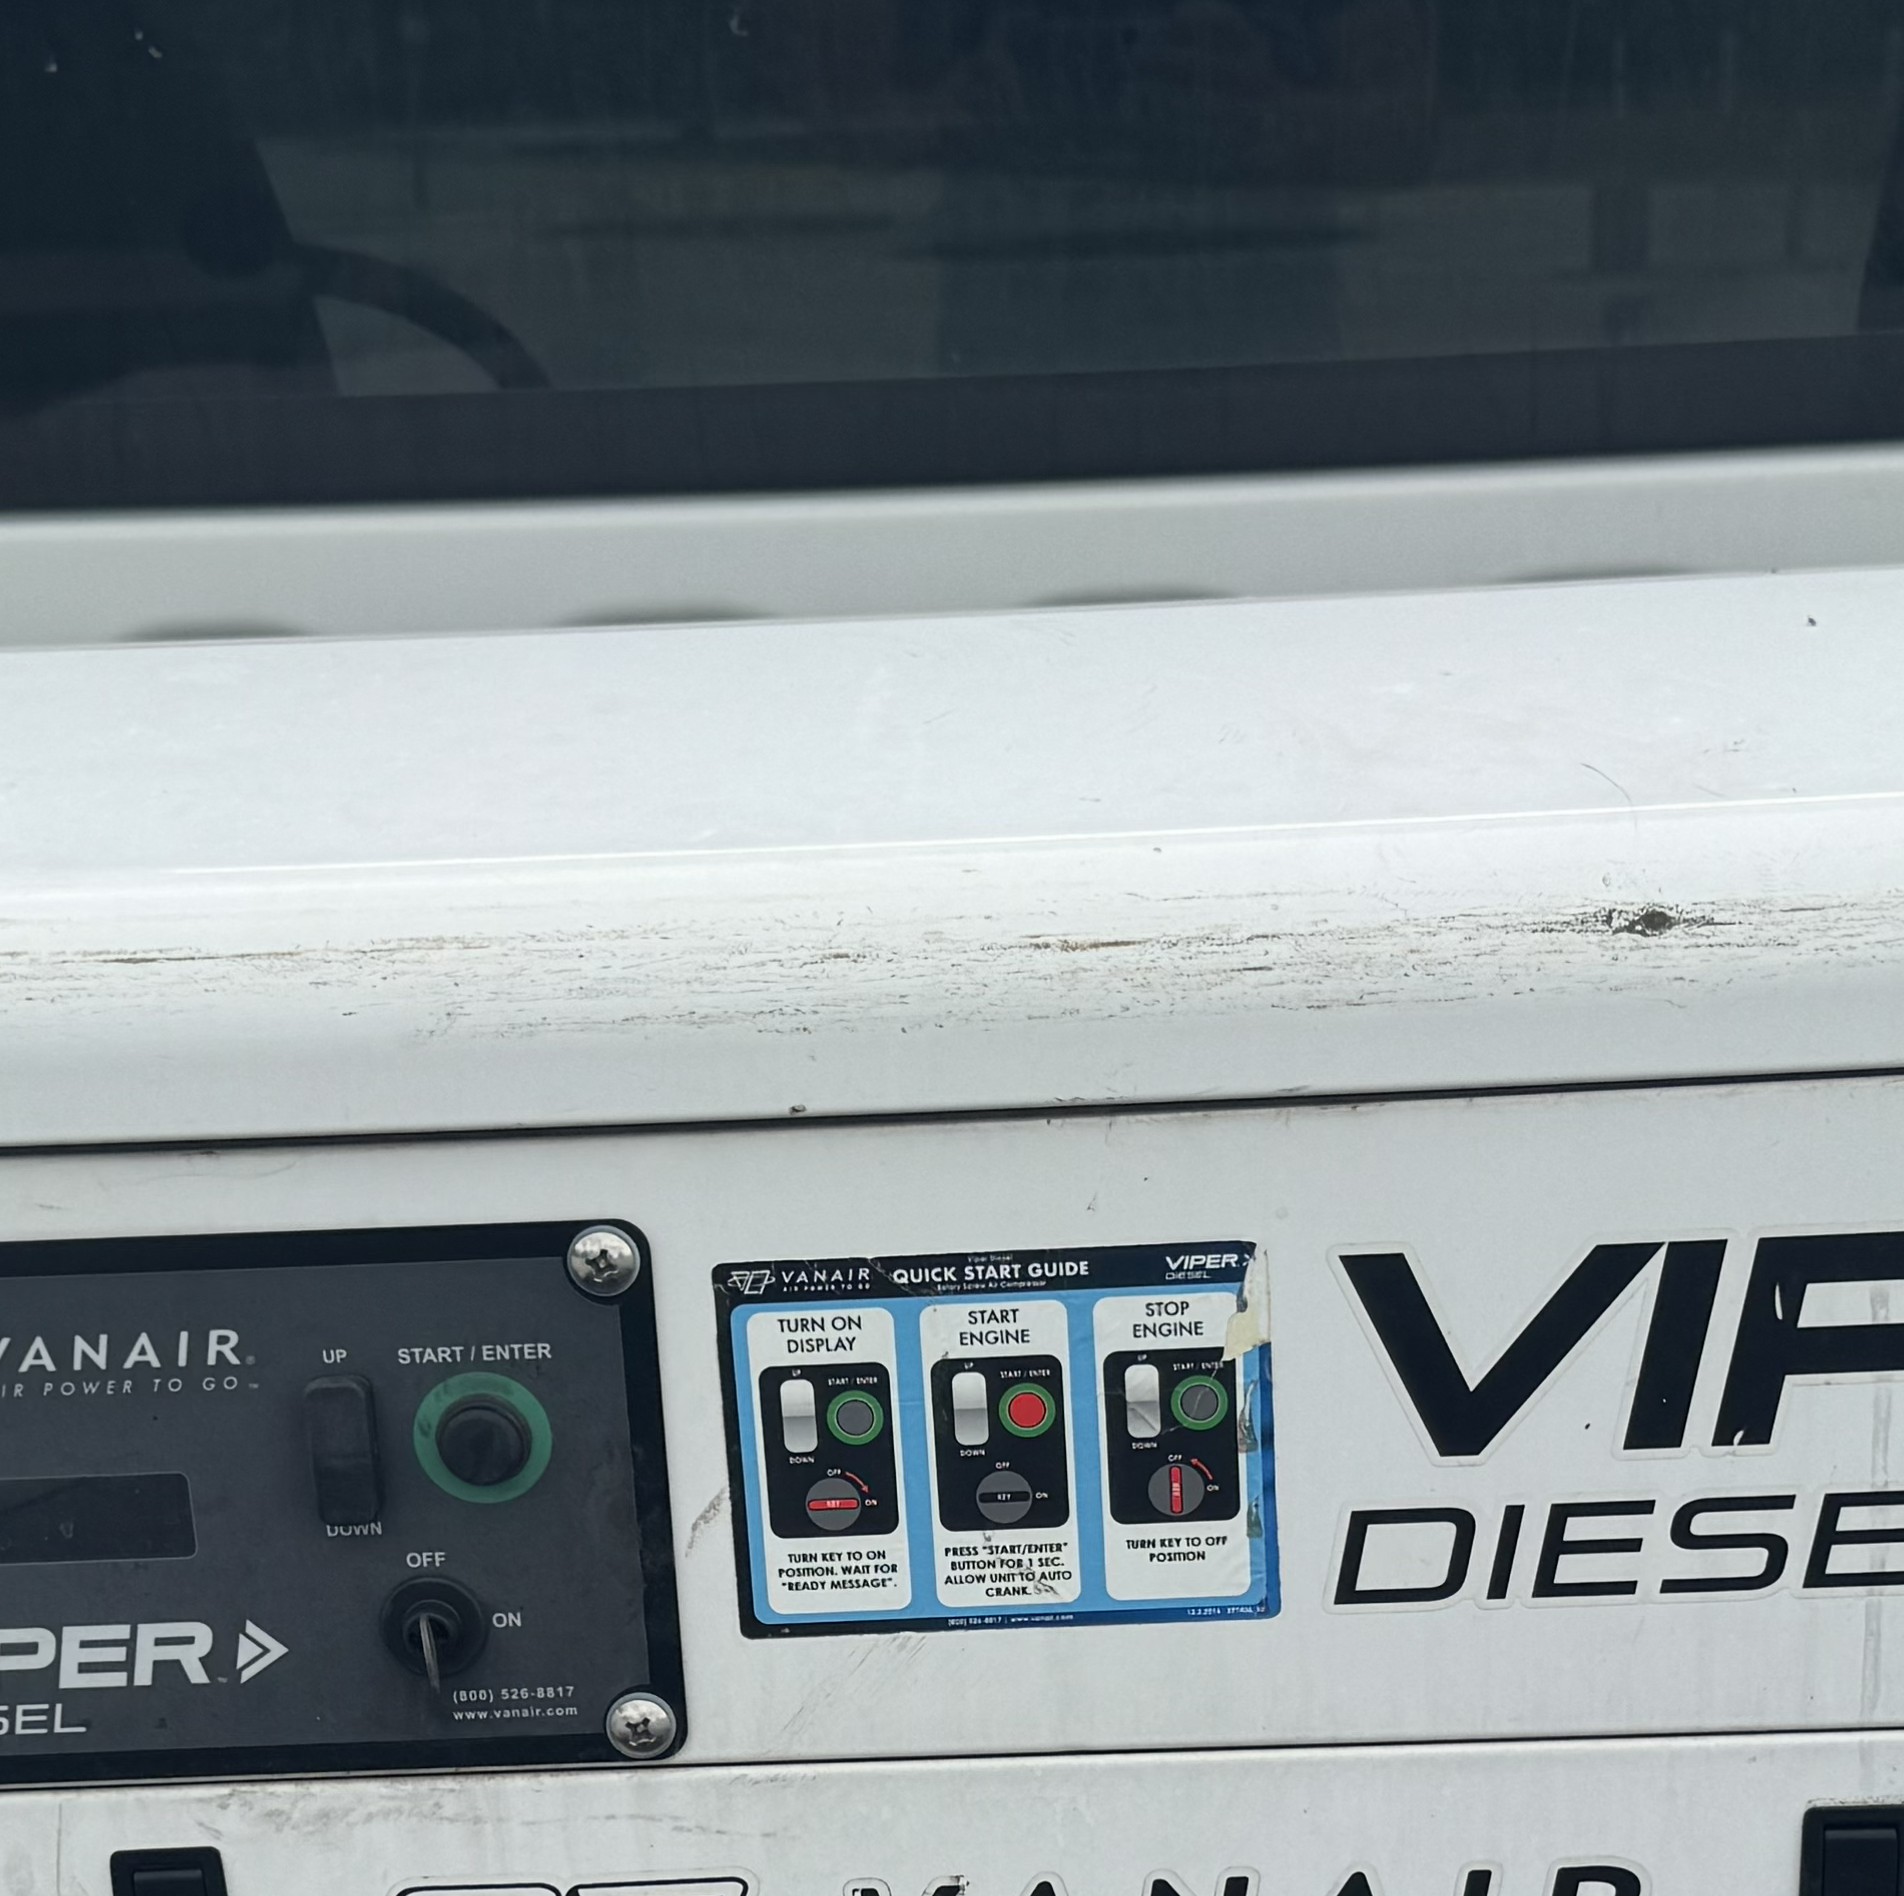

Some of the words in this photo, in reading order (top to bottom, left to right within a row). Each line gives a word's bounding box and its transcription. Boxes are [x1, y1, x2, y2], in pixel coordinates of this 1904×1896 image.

[1165, 1254, 1237, 1271] VIPER
[781, 1268, 870, 1284] VANAIR
[893, 1266, 956, 1284] QUICK
[964, 1264, 1021, 1281] START
[1028, 1261, 1089, 1278] GUIDE
[1165, 1270, 1211, 1281] DIESEL
[968, 1308, 1019, 1325] START
[1145, 1301, 1190, 1317] STOP
[777, 1316, 825, 1333] TURN
[832, 1315, 862, 1331] ON
[1132, 1321, 1204, 1339] ENGINE
[787, 1336, 856, 1353] DISPLAY
[959, 1328, 1030, 1346] ENGINE
[322, 1348, 347, 1364] UP
[397, 1346, 464, 1365] START
[482, 1343, 552, 1361] ENTER
[43, 1379, 133, 1397] POWER
[153, 1378, 183, 1393] TO
[202, 1375, 238, 1391] GO
[789, 1456, 815, 1465] DOWN
[960, 1449, 985, 1458] DOWN
[826, 1468, 842, 1477] OFF
[995, 1462, 1010, 1470] OFF
[865, 1498, 878, 1506] ON
[326, 1521, 382, 1538] DOWN
[945, 1547, 978, 1557] PRESS
[982, 1542, 1068, 1555] "START/ENTER"
[1126, 1538, 1156, 1549] TURN
[1160, 1537, 1181, 1548] KEY
[1185, 1537, 1201, 1547] TO
[1205, 1535, 1227, 1546] OFF
[406, 1552, 446, 1568] OFF
[788, 1552, 818, 1563] TURN
[821, 1551, 843, 1562] KEY
[847, 1551, 863, 1561] TO
[866, 1550, 886, 1560] ON
[951, 1559, 996, 1571] BUTTON
[1000, 1559, 1023, 1569] FOR
[1028, 1558, 1033, 1567] 1
[1038, 1556, 1064, 1567] SEC.
[1149, 1550, 1205, 1562] POSITION
[778, 1566, 838, 1578] POSITION.
[841, 1564, 871, 1575] WAIT
[874, 1564, 898, 1574] FOR
[945, 1574, 986, 1585] ALLOW
[990, 1573, 1016, 1583] UNIT
[1018, 1572, 1036, 1582] TO
[1039, 1570, 1072, 1581] AUTO
[782, 1581, 826, 1591] "READY
[831, 1578, 897, 1590] MESSAGE".
[492, 1611, 522, 1628] ON
[453, 1688, 494, 1704] (800)
[500, 1686, 575, 1700] 526-8817
[452, 1705, 578, 1721] www.vanair.com
